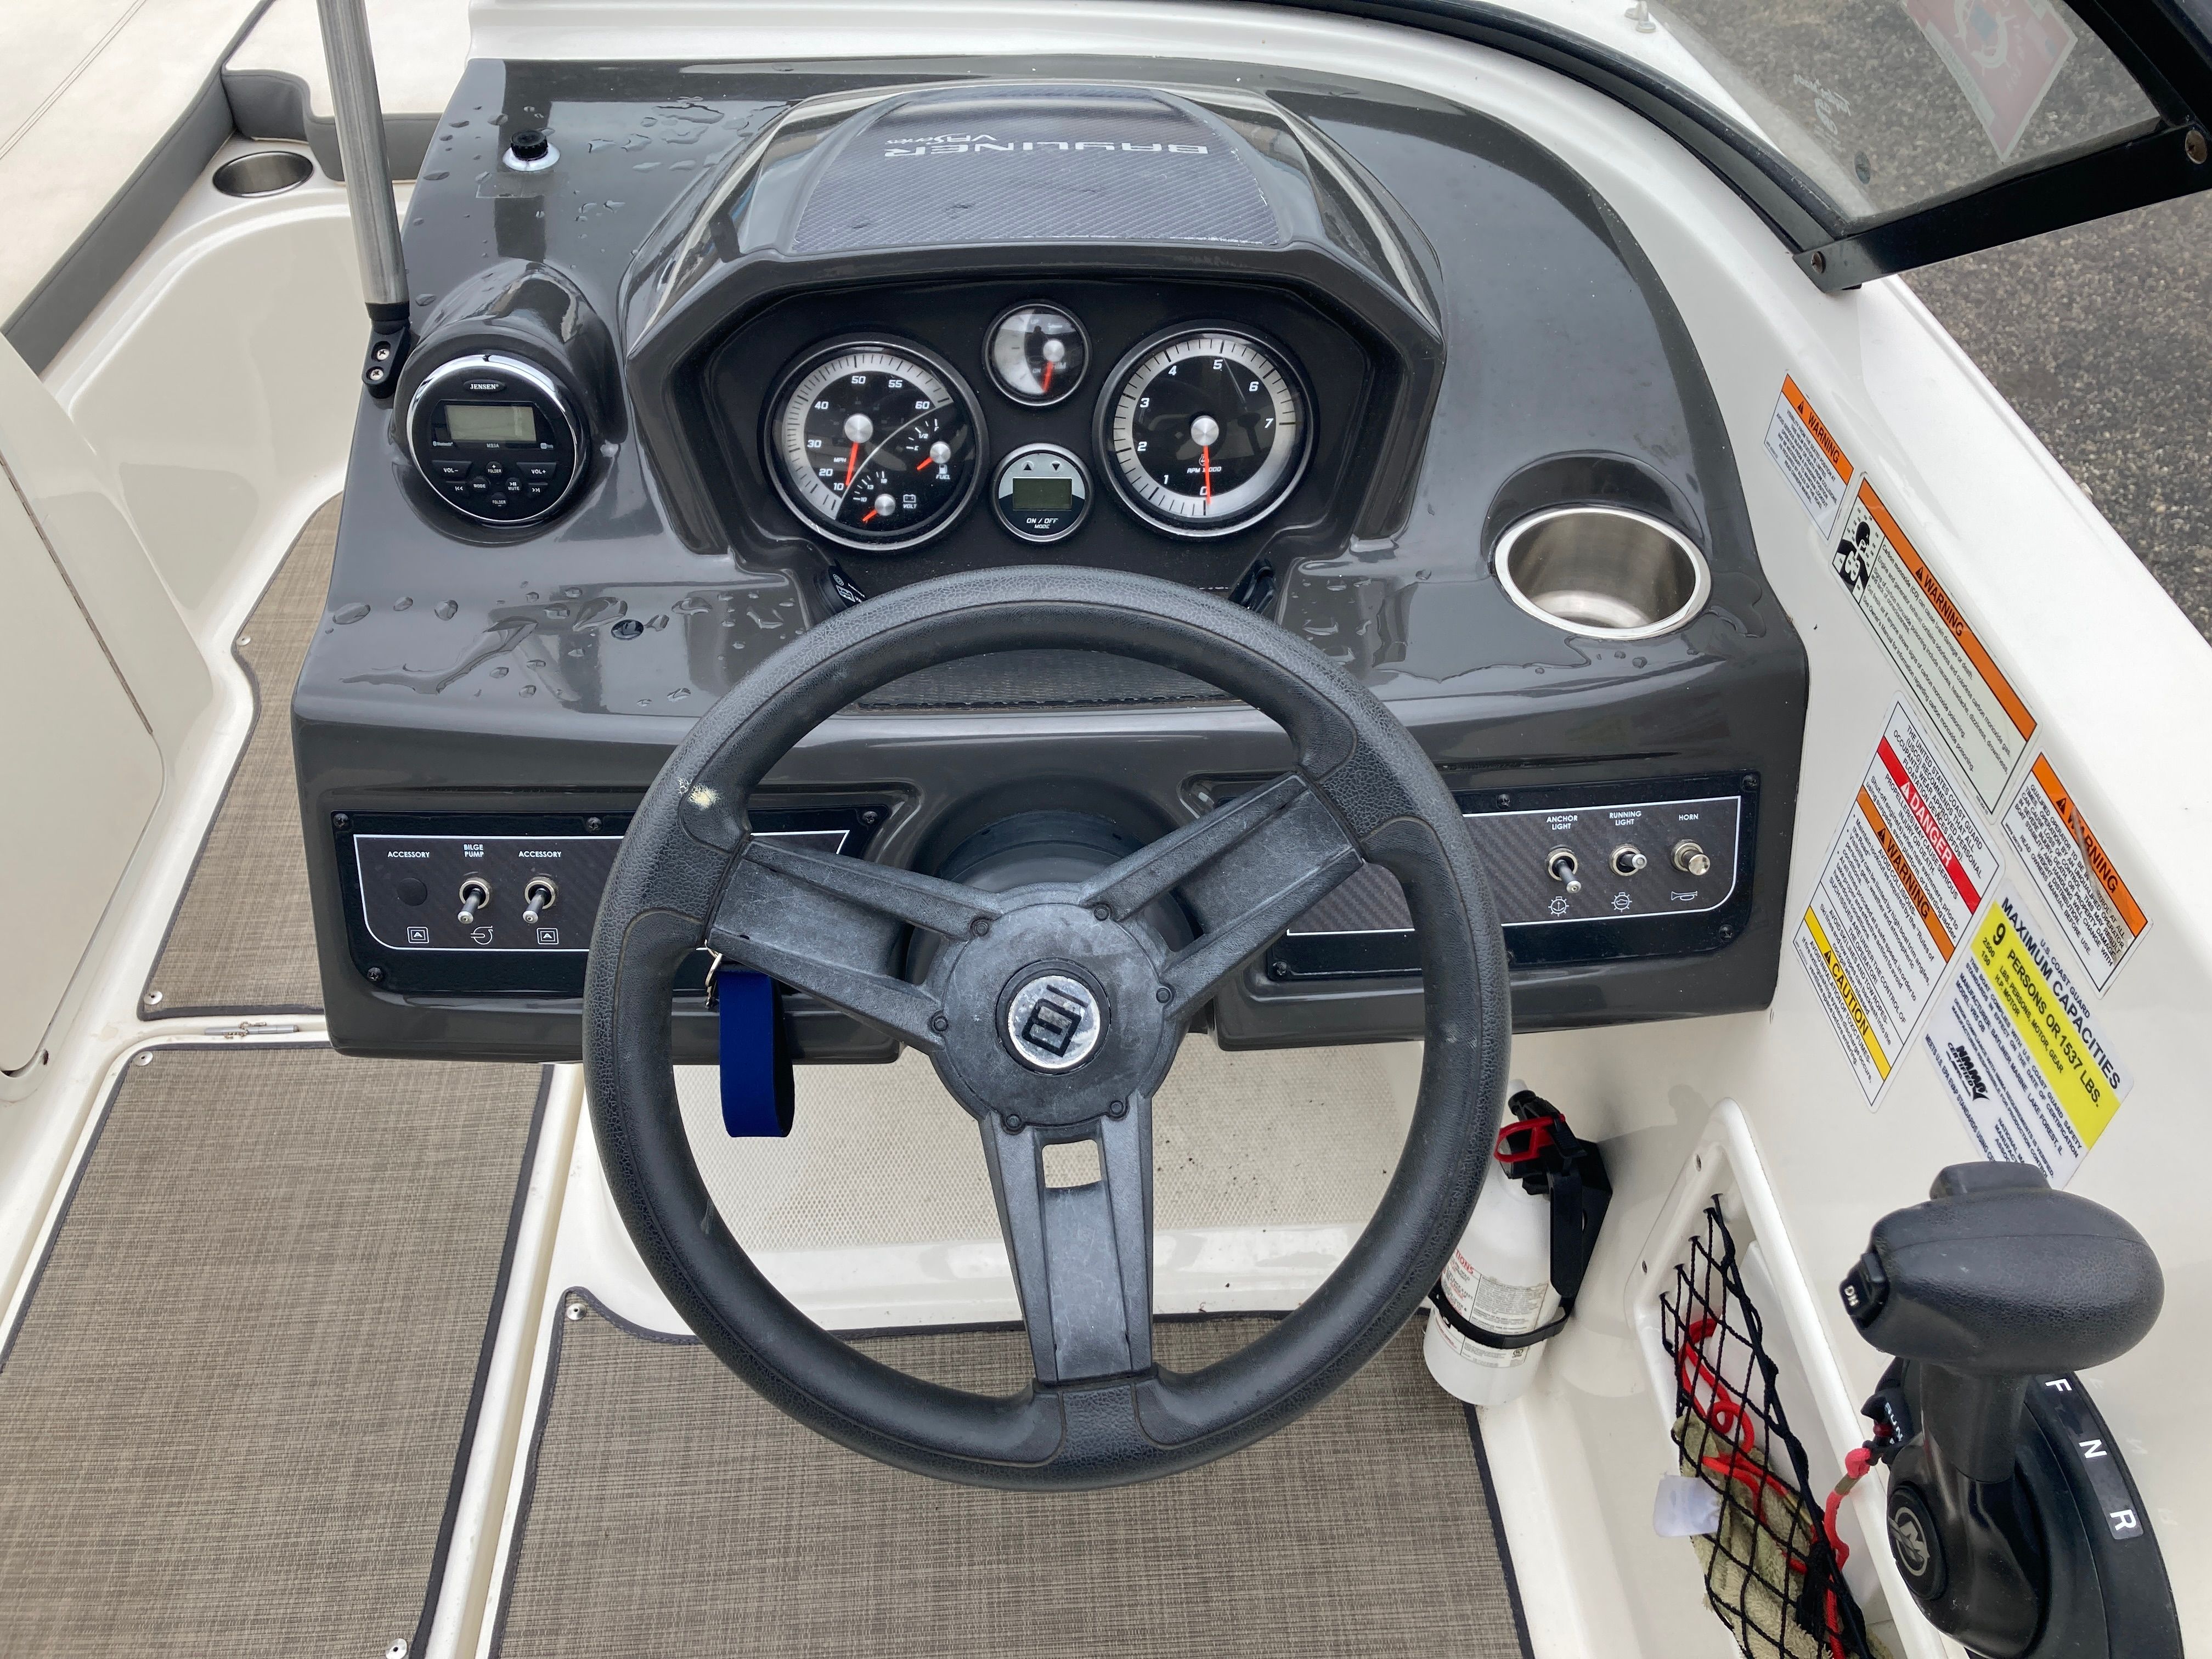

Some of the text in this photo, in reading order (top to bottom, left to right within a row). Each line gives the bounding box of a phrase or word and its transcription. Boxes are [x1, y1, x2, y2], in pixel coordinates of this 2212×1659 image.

[884, 141, 1208, 157] BAYLINER
[851, 376, 902, 388] 50 55
[1169, 365, 1177, 376] 4
[1213, 359, 1223, 370] 5
[1249, 381, 1259, 391] 6
[815, 401, 829, 410] 40
[915, 401, 930, 410] 60
[1140, 398, 1150, 408] 3
[1265, 418, 1273, 428] 7
[807, 439, 822, 448] 30
[1137, 442, 1147, 452] 2
[1807, 411, 1840, 465] WARNING
[819, 468, 833, 477] 20
[833, 482, 844, 491] 10
[1164, 475, 1169, 484] 1
[1200, 486, 1209, 495] 0
[1922, 573, 1965, 638] WARNING
[1893, 729, 1920, 774] OCCUPANTS
[1918, 770, 1933, 797] WEAR
[1931, 792, 1957, 837] APPROVED
[1956, 833, 1983, 879] PERSONAL
[1902, 757, 1964, 863] FLOATATION DEVICES (PFDs).
[1905, 737, 1976, 854] (USCG) RECOMMENDS THAT ALL
[1906, 725, 1916, 742] THE
[1915, 739, 1932, 769] UNITED
[1931, 765, 1949, 797] STATES
[1948, 793, 1965, 822] COAST
[1964, 819, 1983, 851] GUARD
[1546, 815, 1578, 823] ANCHOR
[1609, 811, 1642, 819] RUNNING
[1884, 772, 1958, 901] PROPELLER(S) MAY CAUSE SERIOUS
[1909, 792, 1953, 867] DANGER
[387, 850, 430, 859] ACCESSORY
[1898, 809, 1936, 876] INJURY OR DEATH.
[2066, 809, 2119, 894] RNING
[1886, 839, 1931, 921] WARNING
[2019, 834, 2091, 956] READ OWNERS MANUAL BEFORE USE.
[1831, 960, 1869, 1037] CAUTION
[1980, 949, 2020, 1017] 150 H.P. MOTOR
[2000, 896, 2121, 1091] MAXIMUM CAPACITIES
[2039, 939, 2090, 1019] U.S. COAST GUARD
[1955, 979, 1985, 1033] MODEL: VR5 OB
[1982, 936, 2063, 1074] 2500 LBS. PERSONS, MOTOR, GEAR
[1991, 919, 2103, 1108] 9 PERSONS OR 1537 LBS.
[1947, 1040, 1973, 1088] CERTIFIED
[1959, 973, 2063, 1155] MANUFACTURER: BAYLINER MARINE LAKE FOREST, IL
[1965, 962, 2079, 1159] STANDARDS IN EFFECT ON THE DATE OF CERTIFICATION
[1969, 957, 2082, 1150] THIS BOAT COMPLIES WITH U.S. COAST GUARD SAFETY
[2045, 1379, 2072, 1391] F
[2079, 1439, 2107, 1458] N
[2110, 1509, 2136, 1531] R
